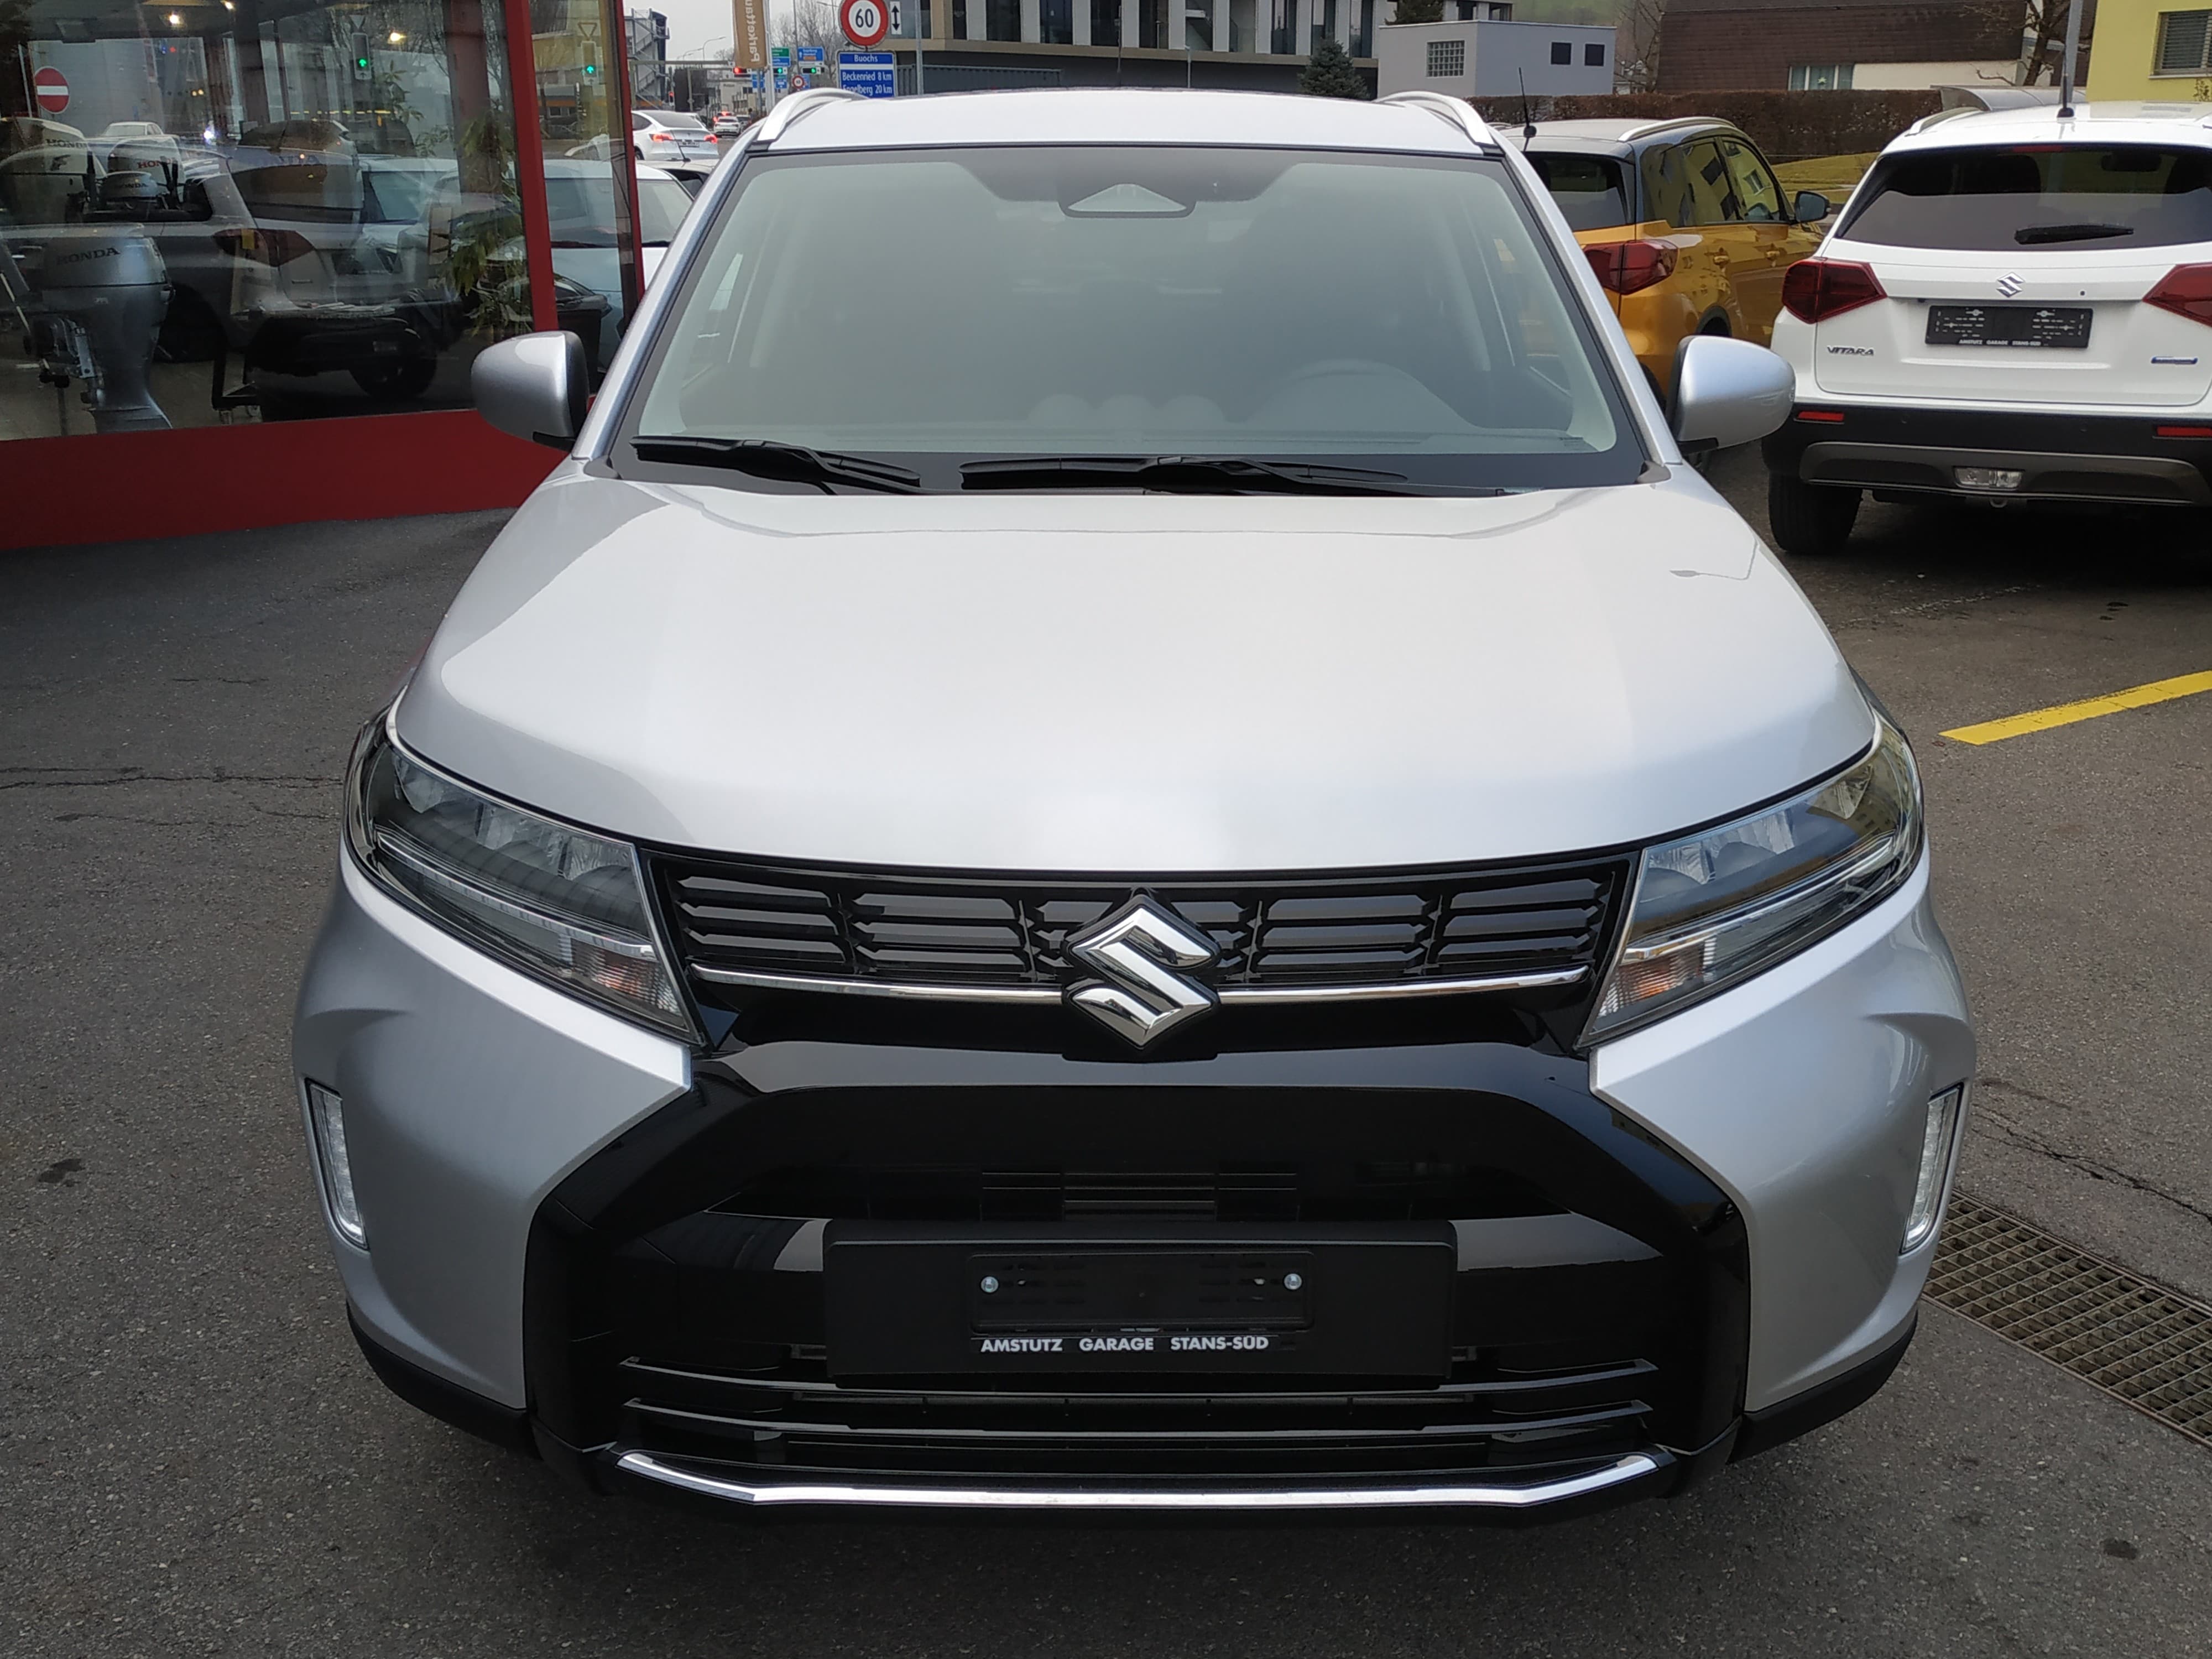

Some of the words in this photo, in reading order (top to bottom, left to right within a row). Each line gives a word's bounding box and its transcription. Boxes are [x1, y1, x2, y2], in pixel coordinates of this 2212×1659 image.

[855, 8, 874, 28] 60
[842, 71, 876, 81] Beckenried
[878, 71, 883, 81] 8
[883, 71, 893, 81] km
[875, 84, 883, 94] 20
[883, 84, 893, 94] km
[56, 247, 121, 265] HONDA
[1827, 346, 1874, 356] VITARA
[980, 1339, 1063, 1352] AMSTUTZ
[1079, 1337, 1154, 1352] GARAGE
